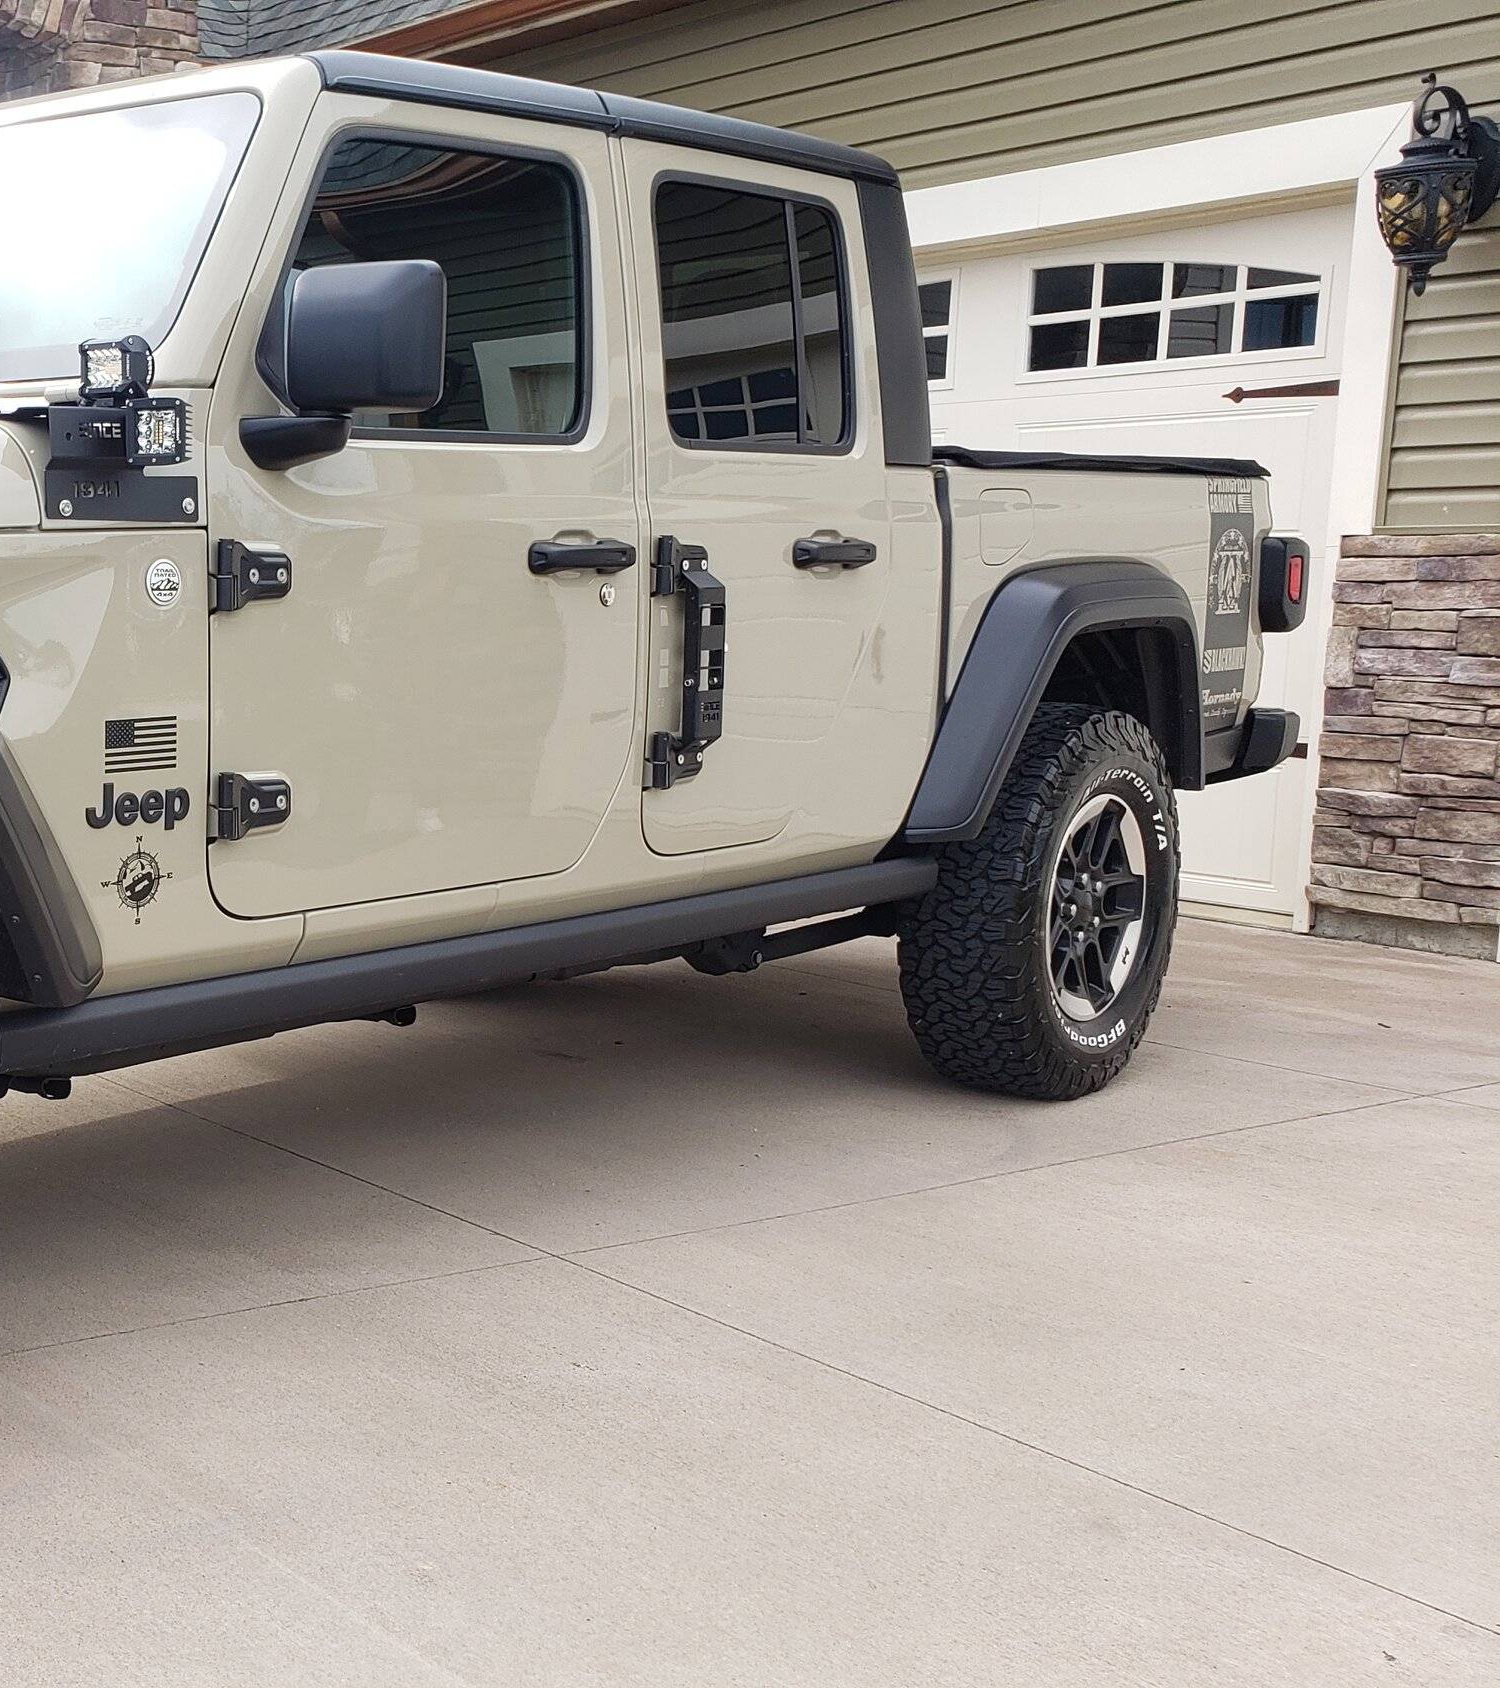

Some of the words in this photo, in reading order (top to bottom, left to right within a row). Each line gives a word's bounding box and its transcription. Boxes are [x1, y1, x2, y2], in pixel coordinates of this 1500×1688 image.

[73, 480, 121, 498] 1941
[85, 782, 190, 830] Jeep
[1082, 768, 1155, 803] All-Terrain
[1152, 809, 1169, 851] T/A
